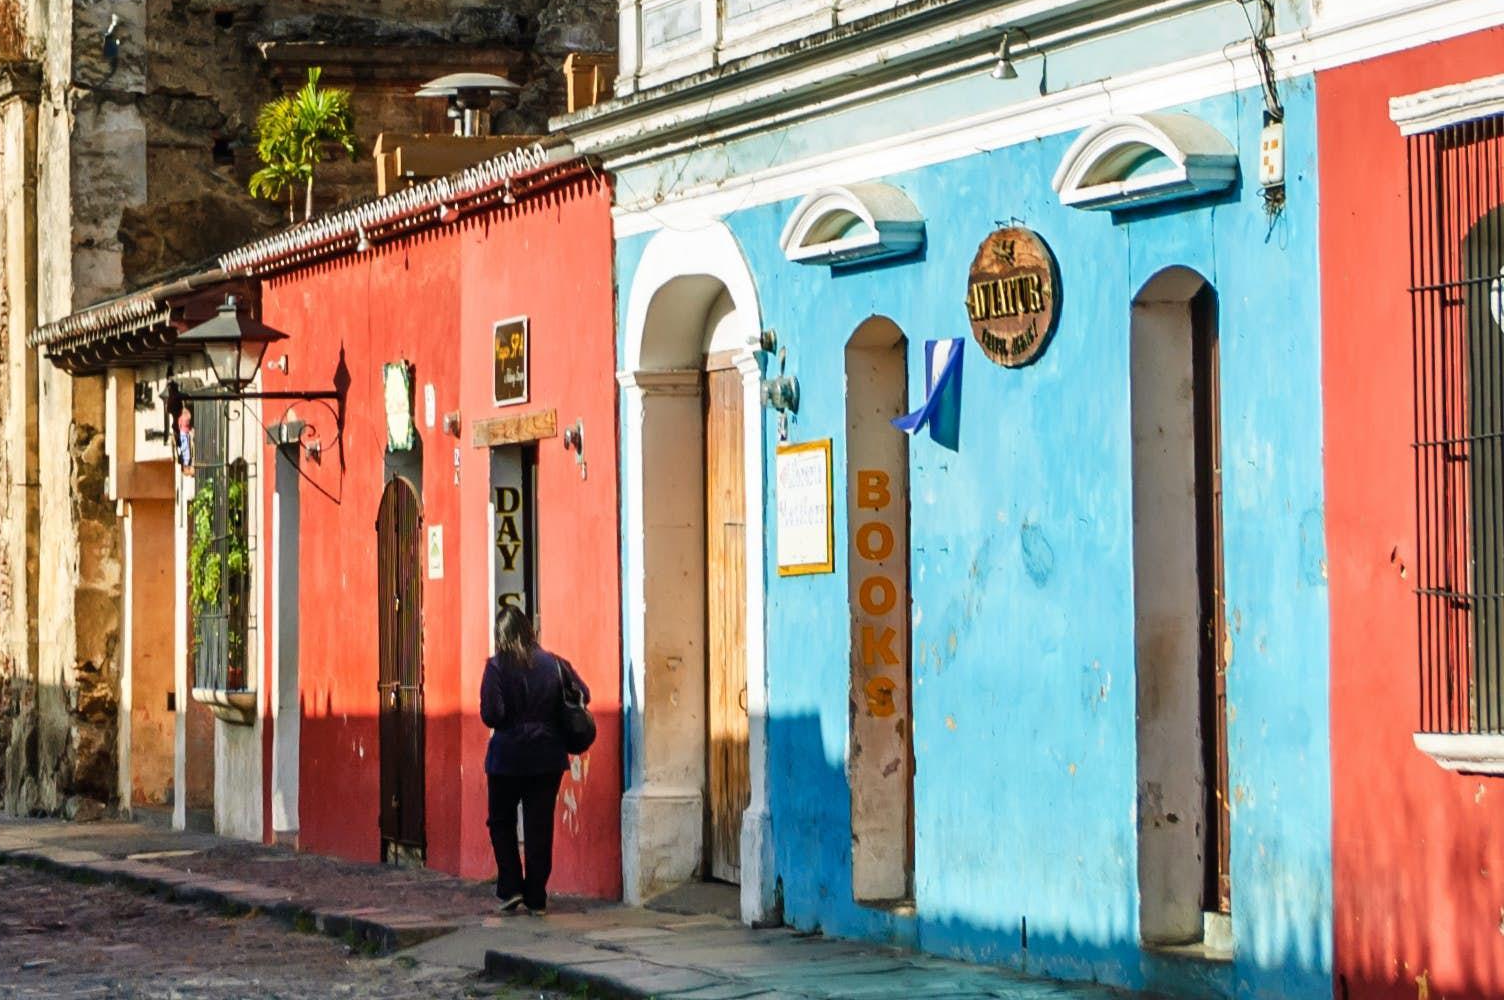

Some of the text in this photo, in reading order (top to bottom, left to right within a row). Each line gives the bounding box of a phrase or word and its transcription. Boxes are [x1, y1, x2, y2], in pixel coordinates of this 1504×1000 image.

[969, 272, 1043, 320] AVIATUR
[495, 486, 521, 572] DAY
[856, 469, 901, 718] BOOKS
